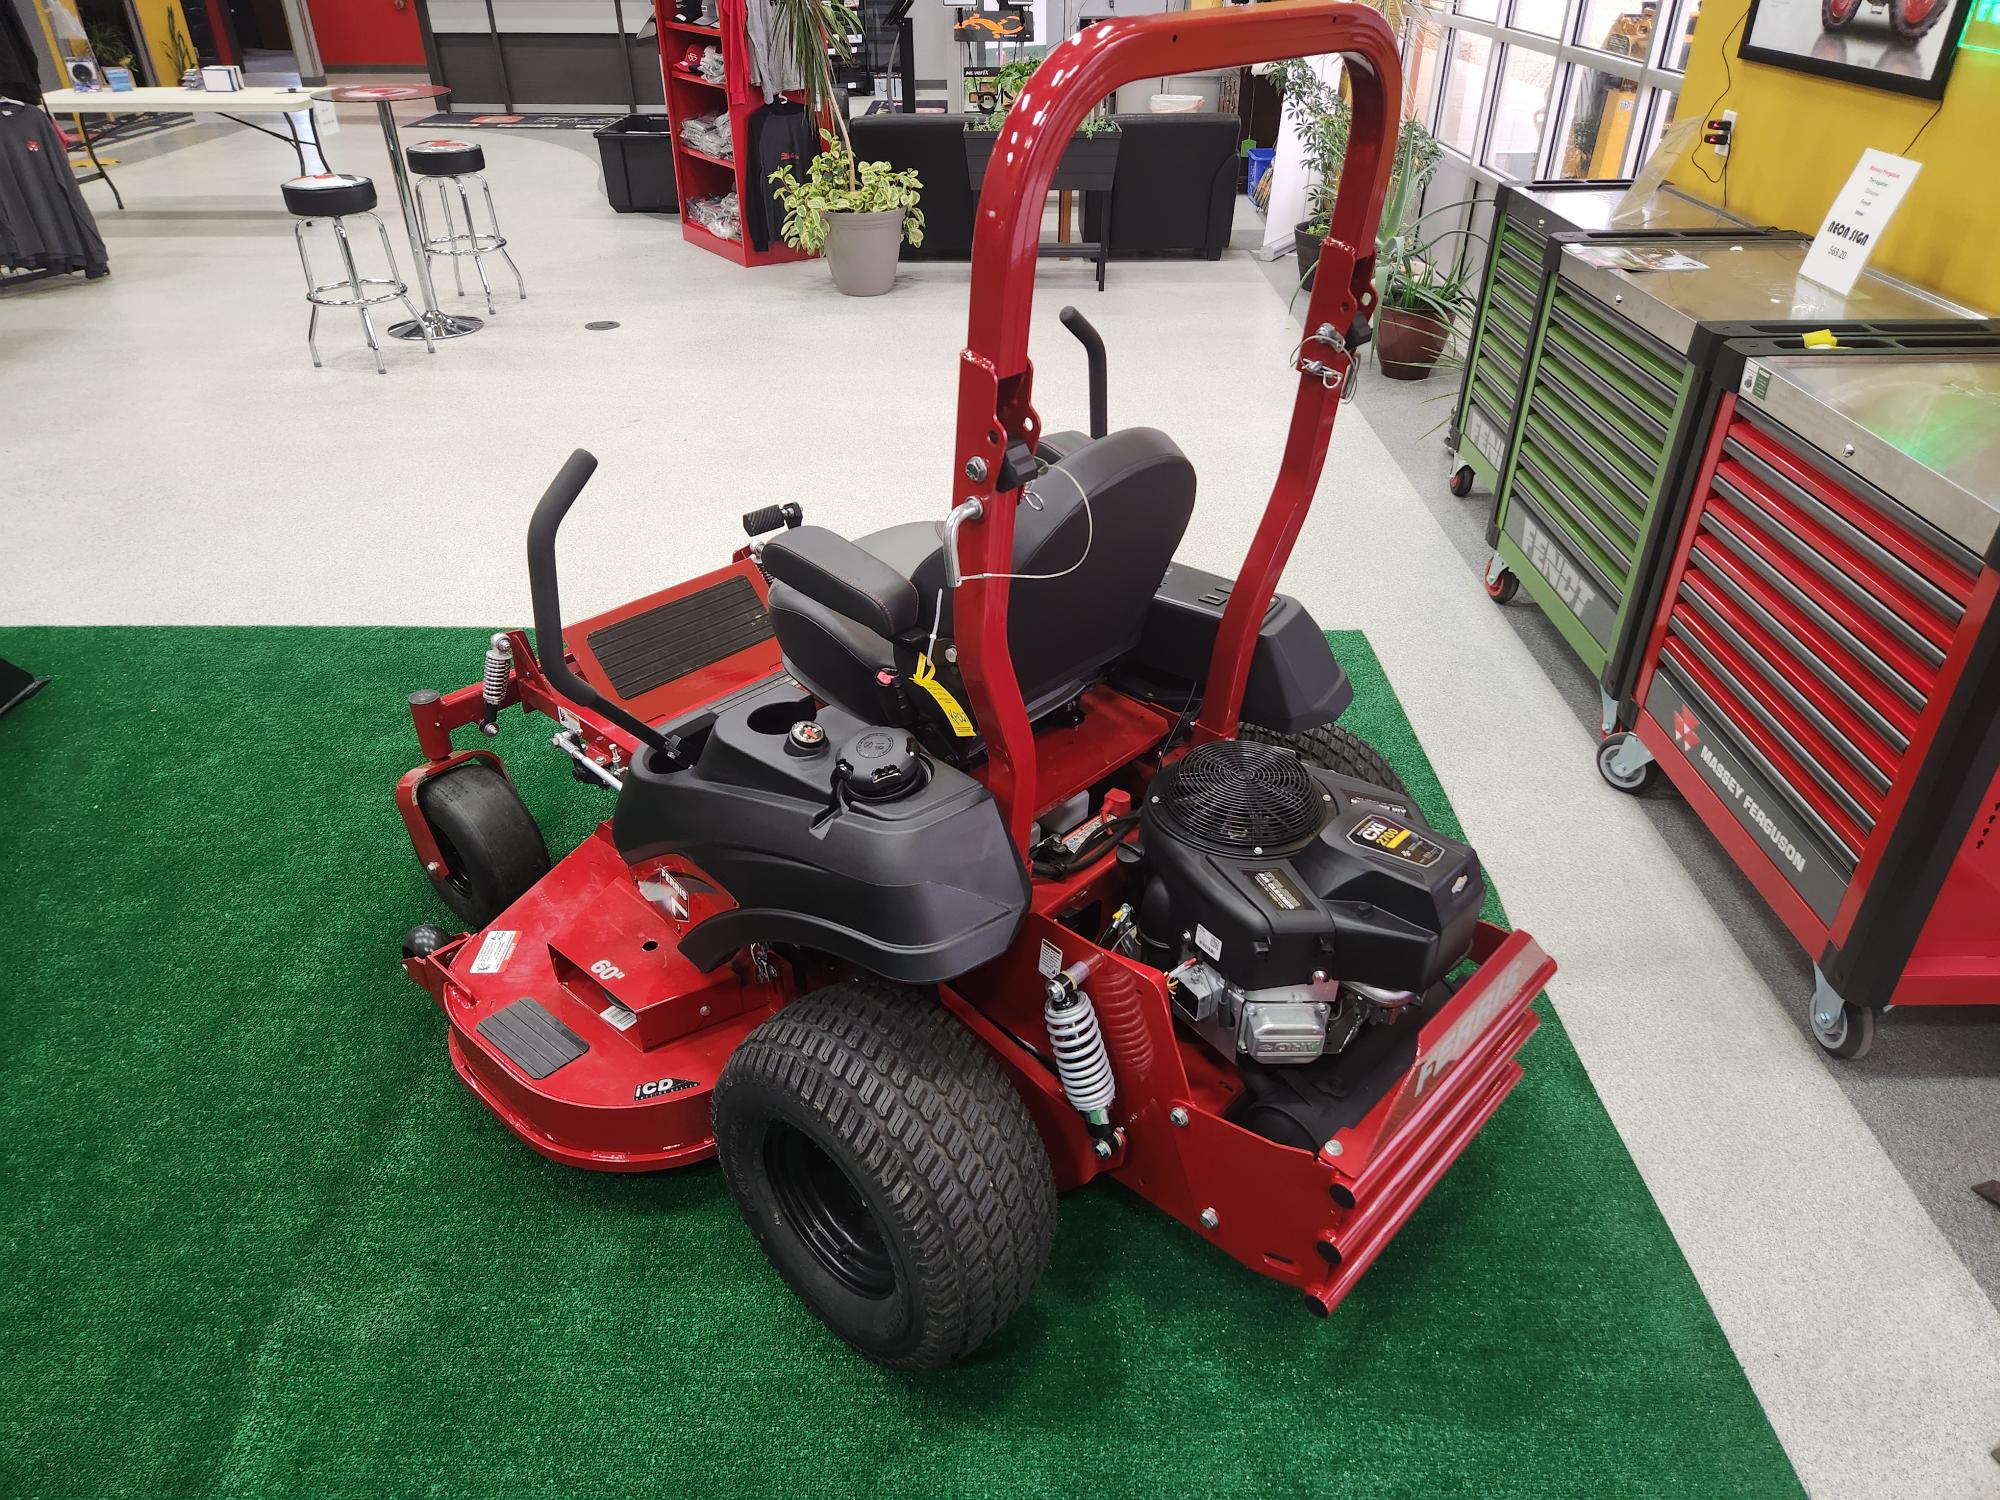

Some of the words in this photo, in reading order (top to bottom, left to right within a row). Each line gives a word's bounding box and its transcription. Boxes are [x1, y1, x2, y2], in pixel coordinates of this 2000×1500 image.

[1827, 220, 1851, 239] NEON
[1849, 229, 1870, 246] SIGN
[1521, 516, 1596, 617] FENDT
[1700, 744, 1744, 799] MASSEY
[1743, 794, 1806, 873] FERGUSON
[1375, 828, 1399, 847] 2700
[661, 868, 688, 901] FERRIS
[591, 959, 626, 980] 60"
